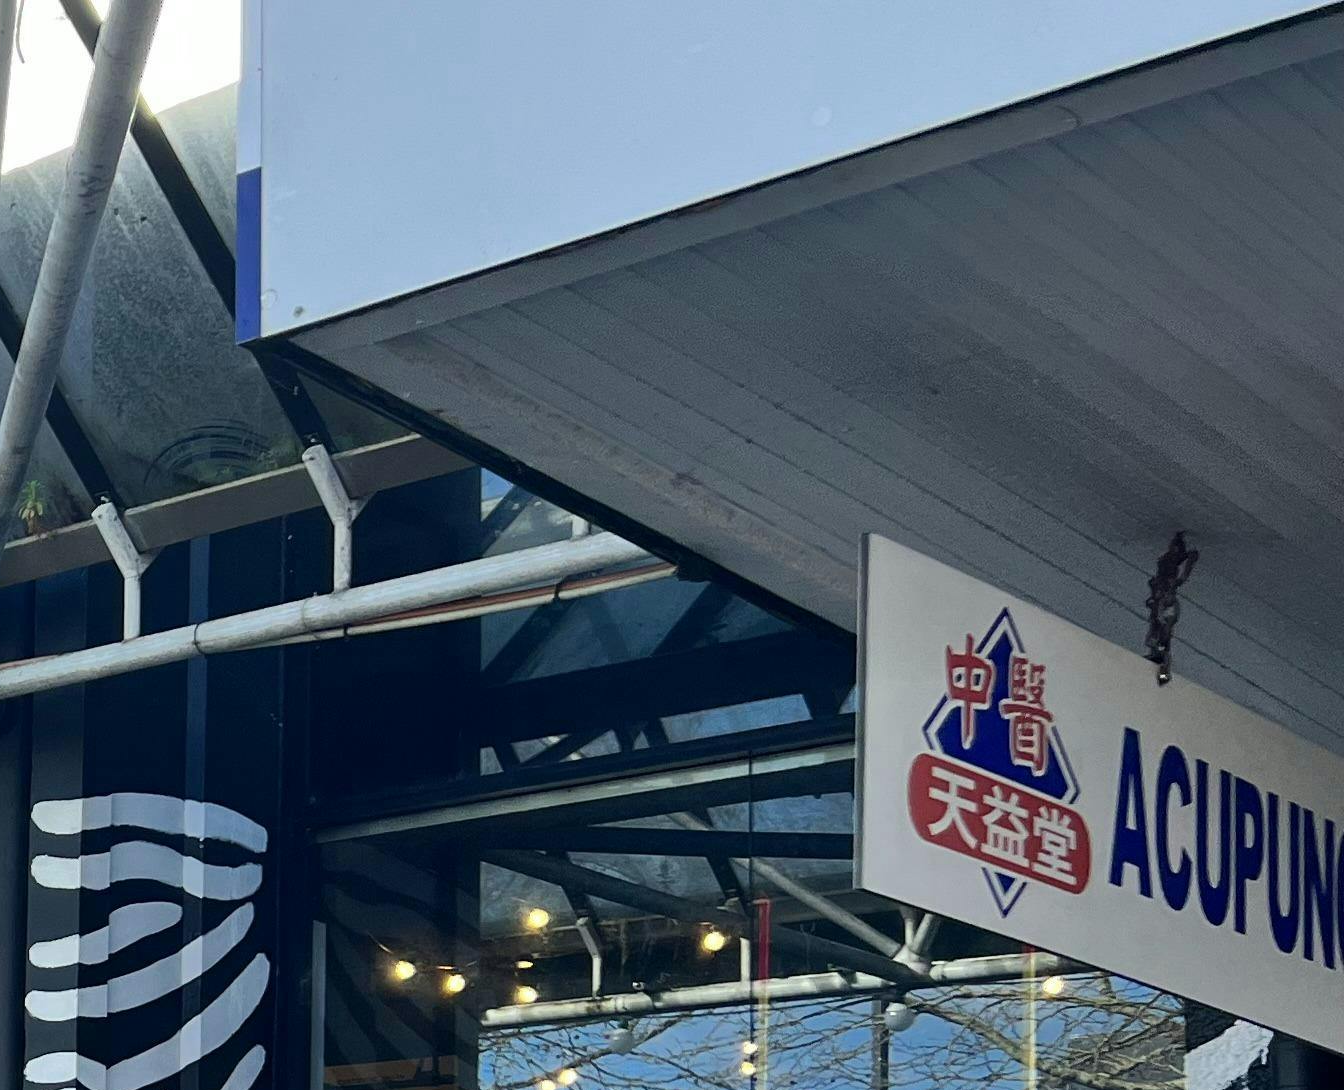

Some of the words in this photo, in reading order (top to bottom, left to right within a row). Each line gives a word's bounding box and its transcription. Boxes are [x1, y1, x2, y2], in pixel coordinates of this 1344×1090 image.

[926, 765, 1079, 885] 天益堂
[1109, 727, 1344, 971] ACUPUN
